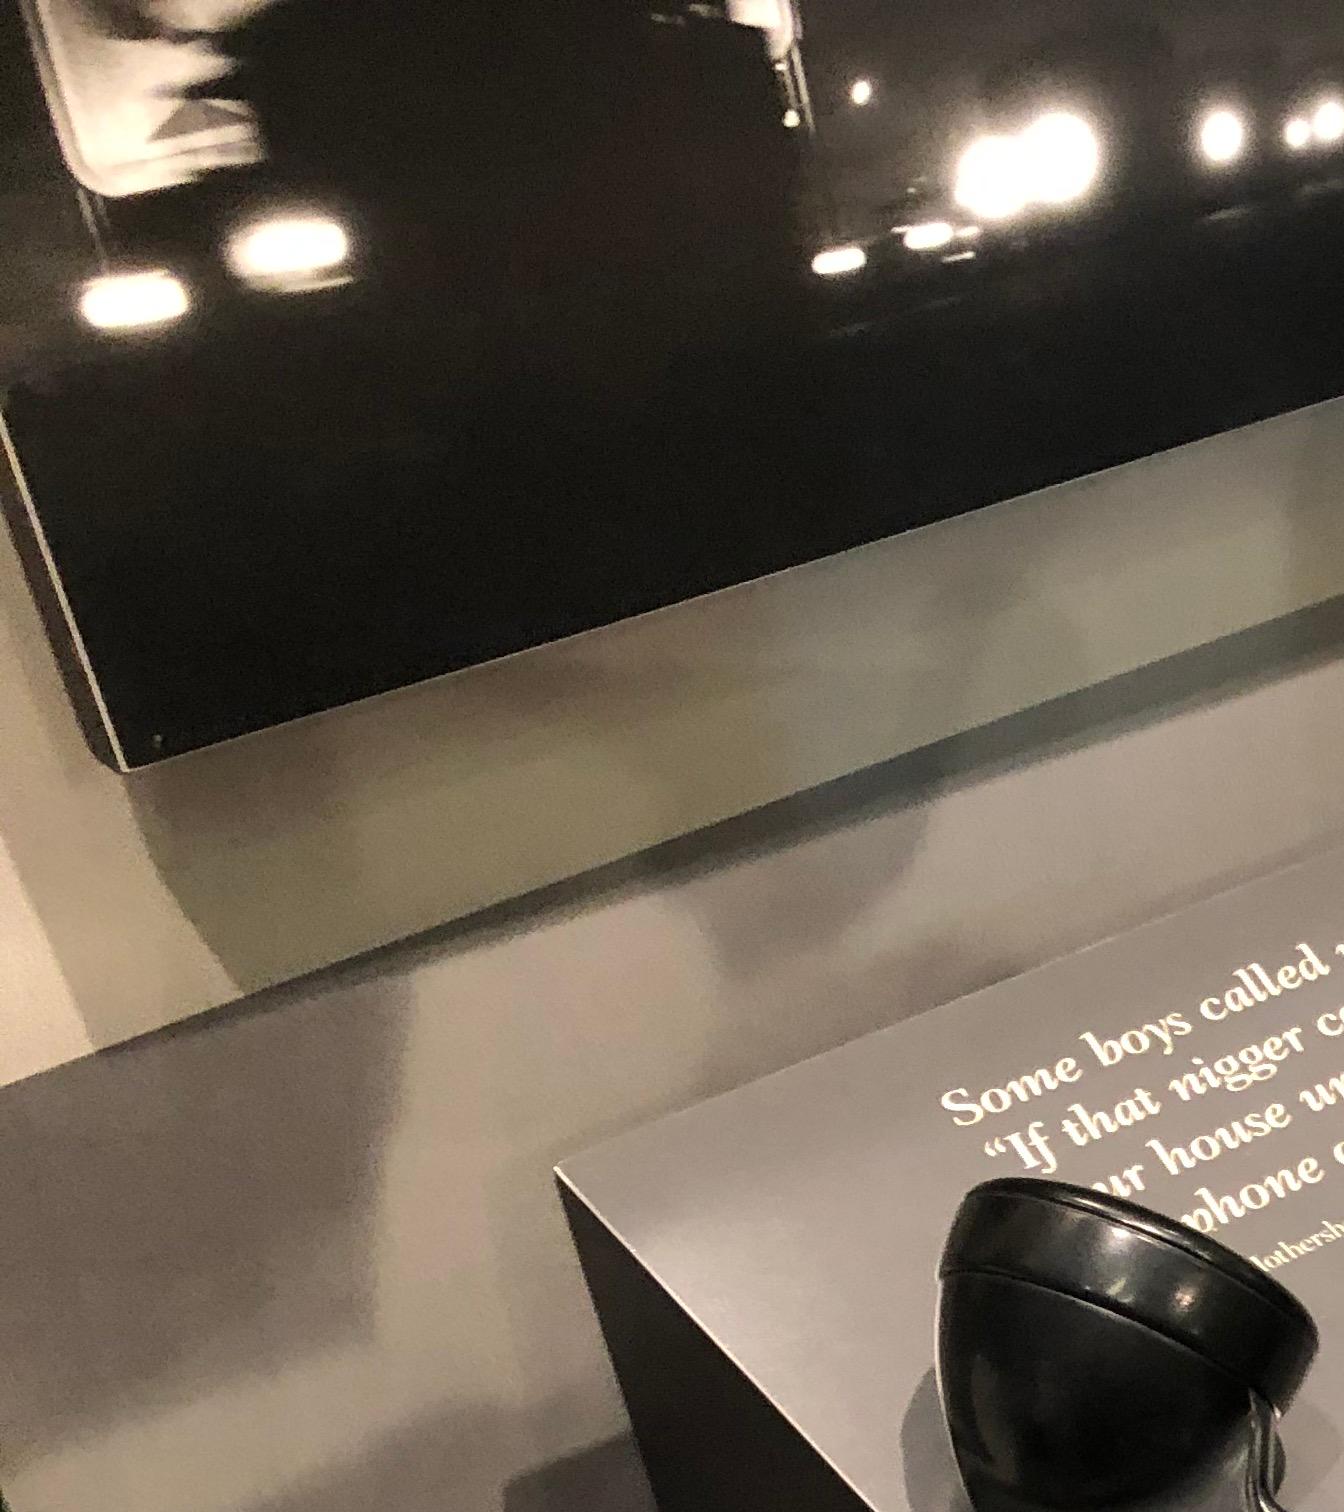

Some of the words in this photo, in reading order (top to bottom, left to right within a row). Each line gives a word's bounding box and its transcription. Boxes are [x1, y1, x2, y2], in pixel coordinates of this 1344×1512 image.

[940, 1056, 1082, 1126] Some
[1078, 1012, 1192, 1066] boys
[1199, 942, 1330, 1020] called
[1061, 1087, 1161, 1146] that
[1167, 1026, 1304, 1101] nigger
[1091, 1164, 1145, 1197] ur
[1144, 1102, 1291, 1175] house
